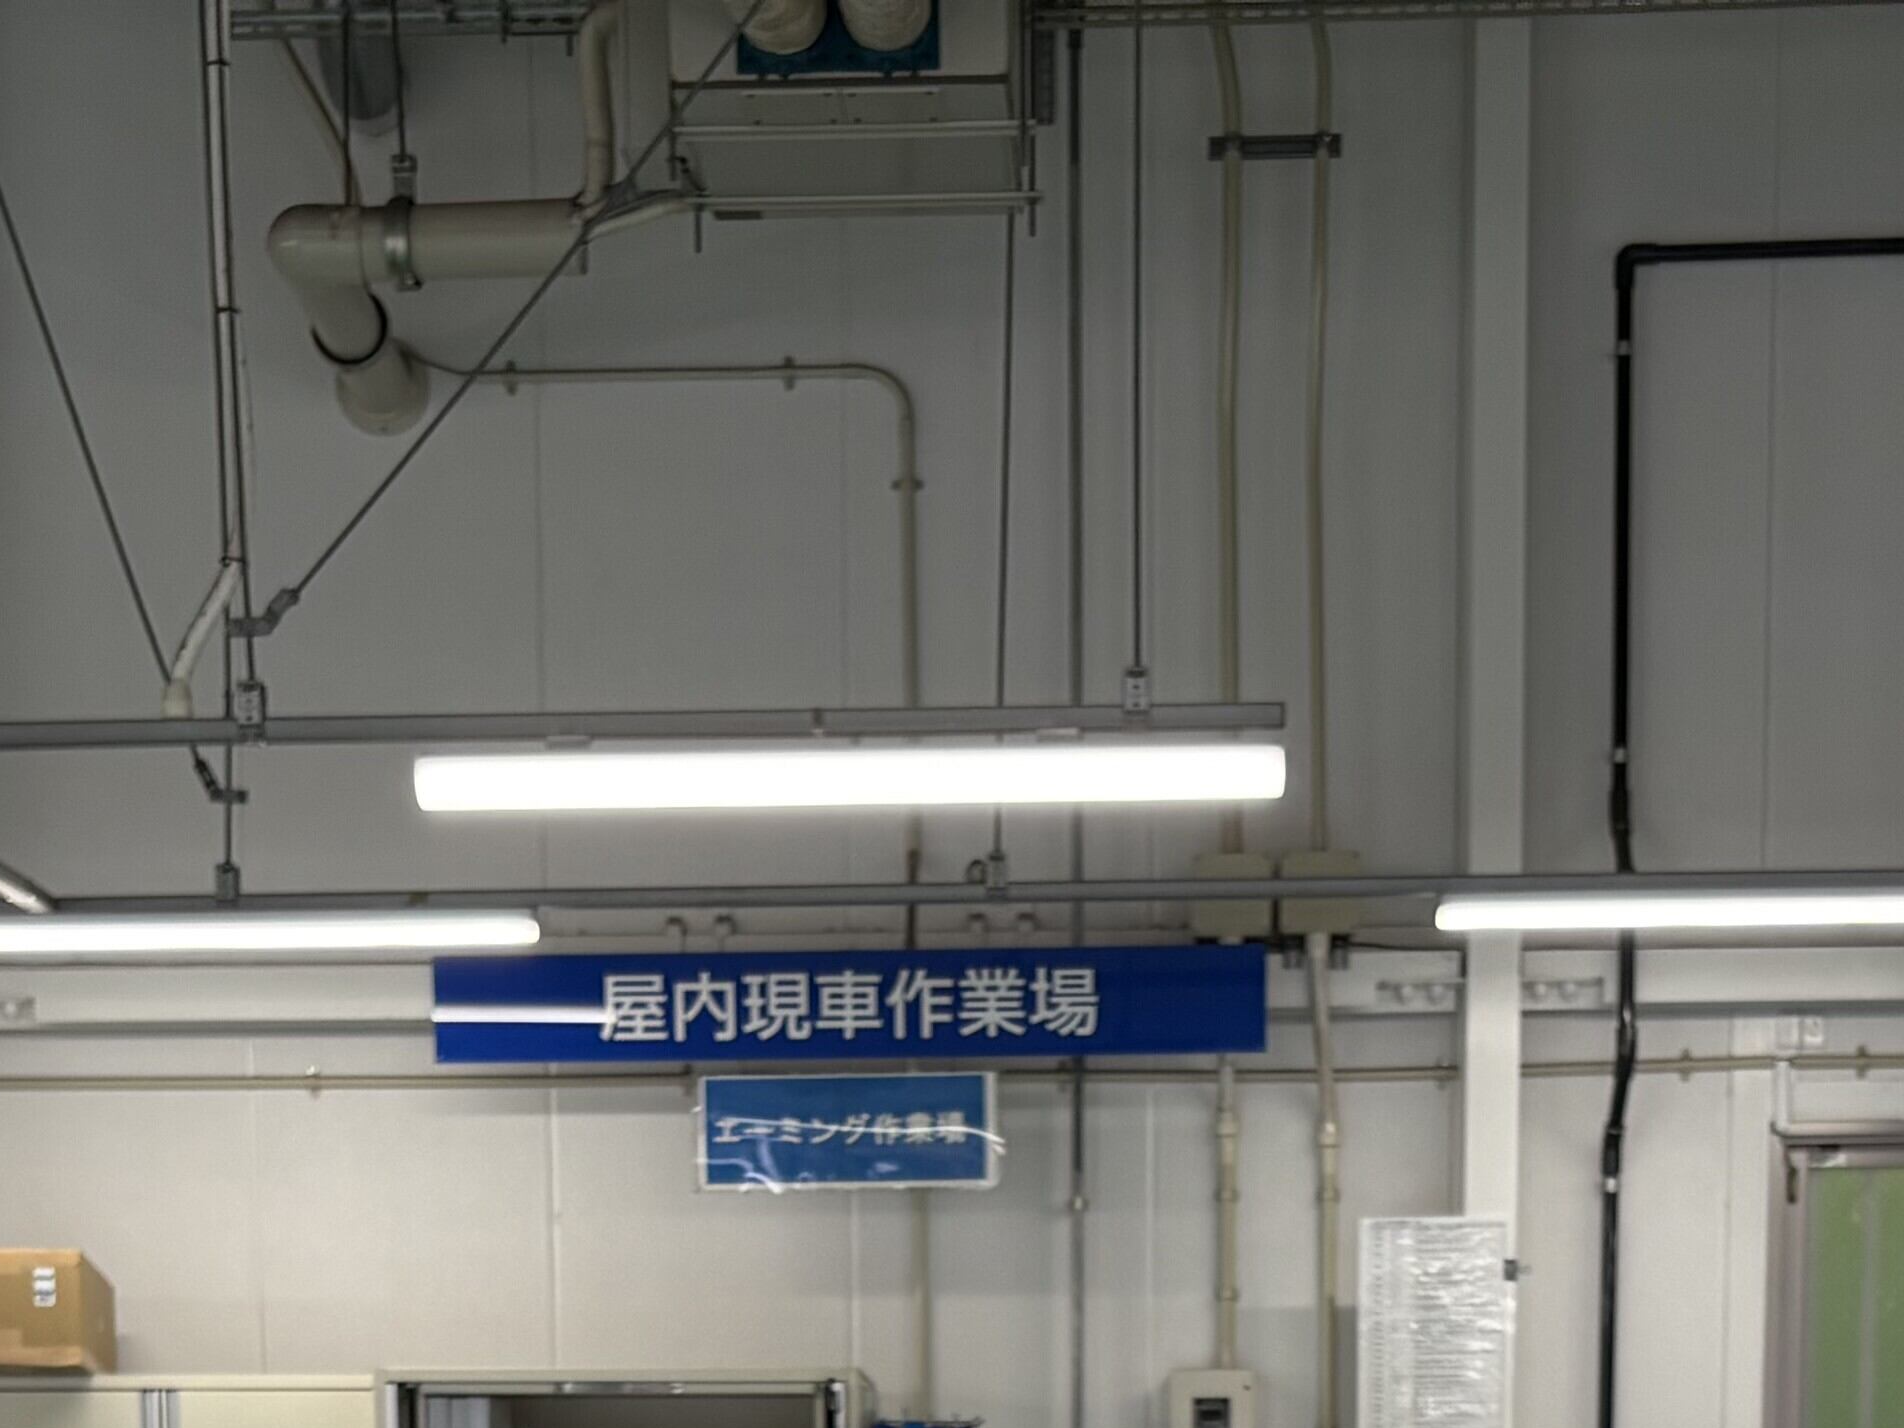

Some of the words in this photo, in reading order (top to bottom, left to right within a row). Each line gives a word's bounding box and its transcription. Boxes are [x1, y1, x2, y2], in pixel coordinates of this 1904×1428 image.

[599, 968, 1099, 1043] 屋内現車作業場
